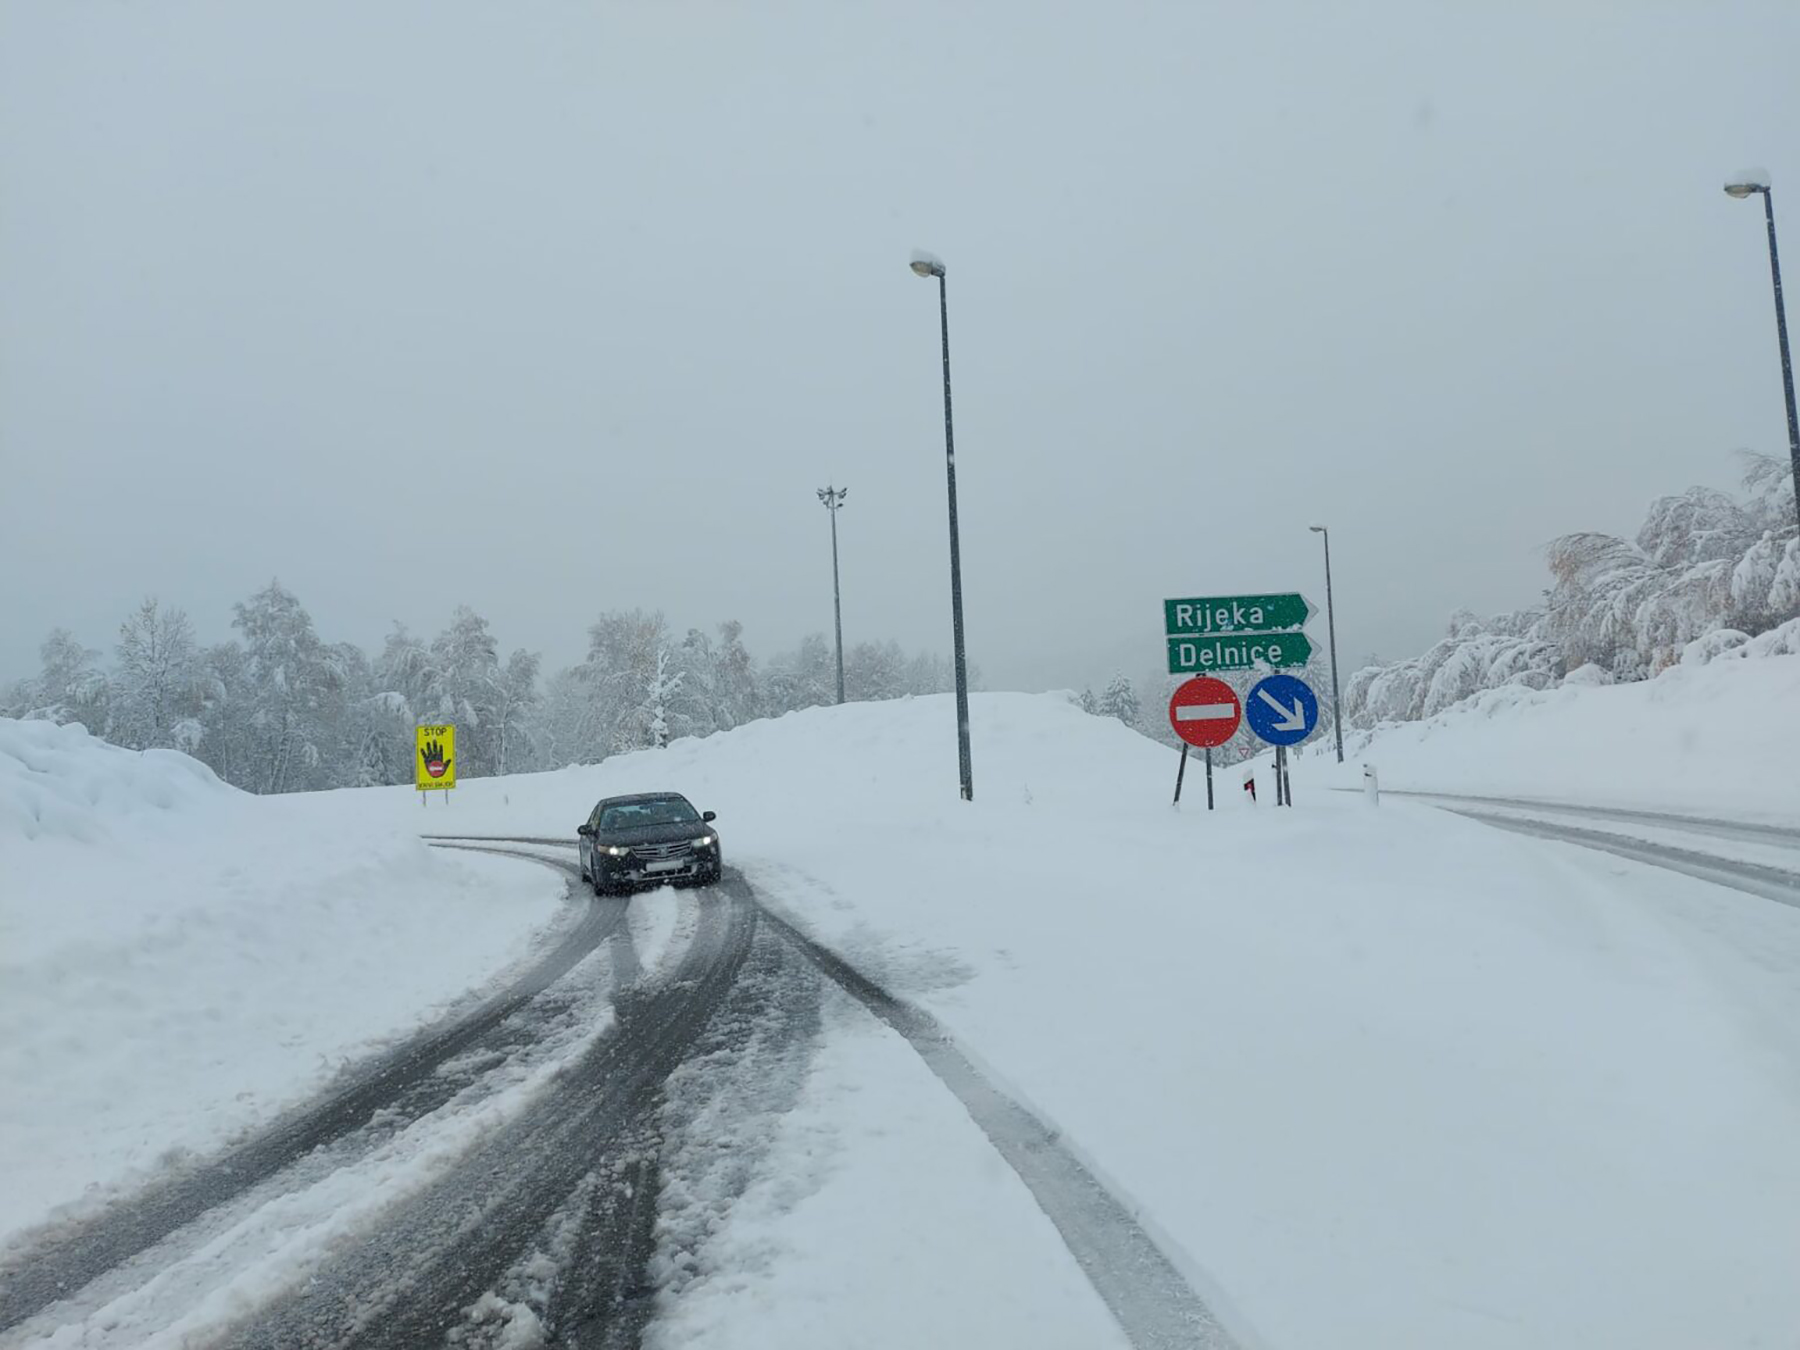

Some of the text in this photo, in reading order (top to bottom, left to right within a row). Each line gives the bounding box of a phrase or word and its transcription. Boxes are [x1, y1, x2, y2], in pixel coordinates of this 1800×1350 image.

[1176, 601, 1264, 632] Rijeka
[1179, 642, 1282, 667] Delnice
[424, 728, 447, 736] STOP
